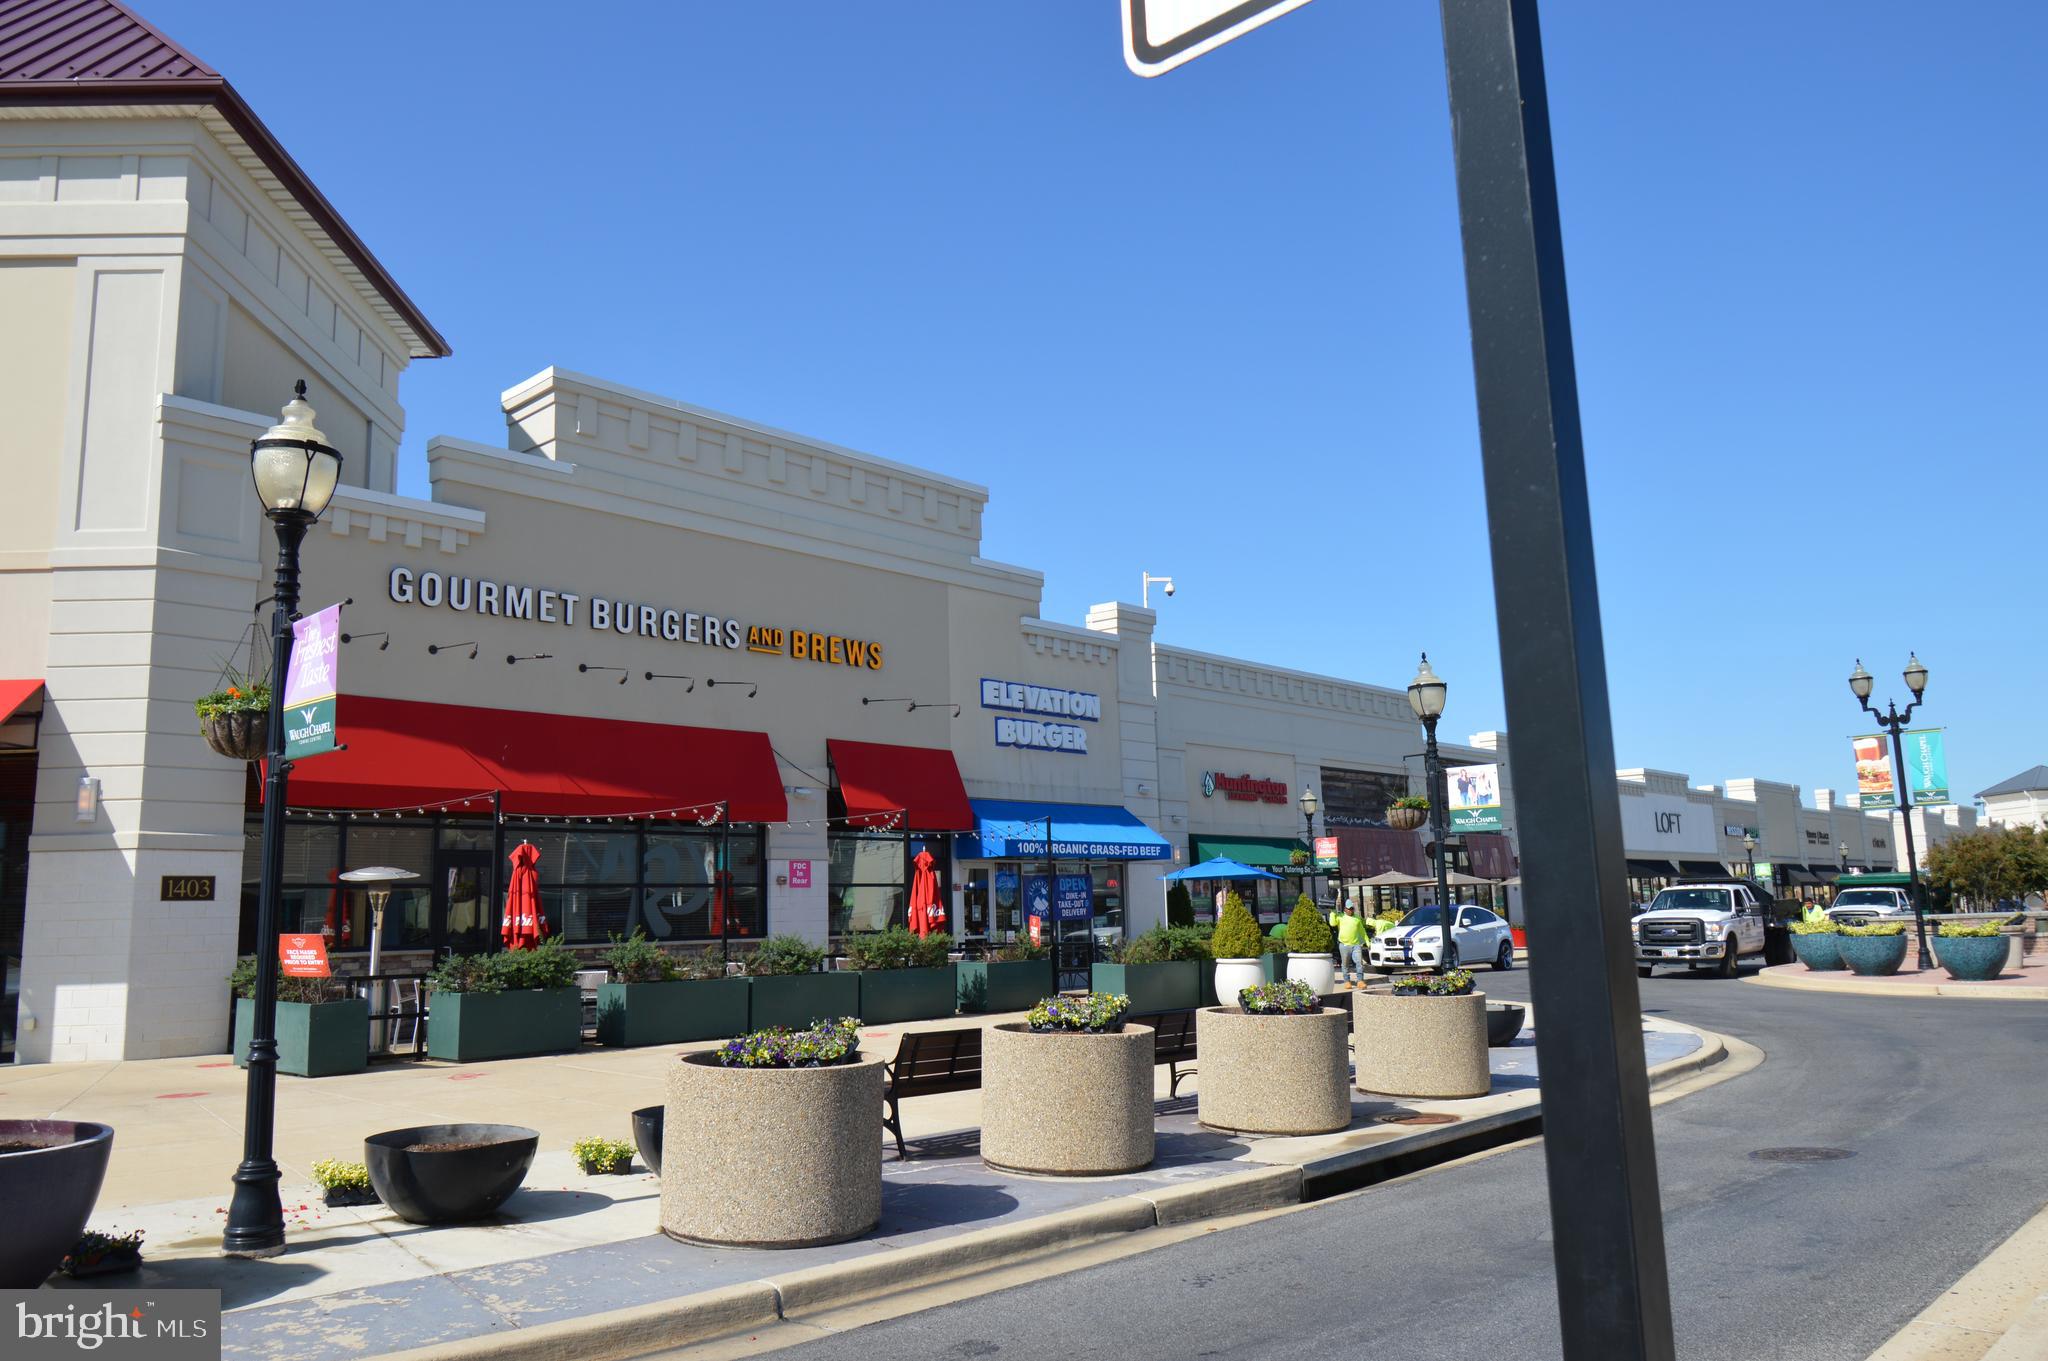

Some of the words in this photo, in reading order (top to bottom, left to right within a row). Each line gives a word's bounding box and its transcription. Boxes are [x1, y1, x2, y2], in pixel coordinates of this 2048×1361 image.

[389, 567, 580, 626] GOURMET
[590, 597, 741, 650] BURGERS
[747, 625, 785, 648] AND
[790, 630, 884, 670] BREWS
[300, 663, 330, 689] Taste
[983, 680, 1100, 720] ELEVATION
[288, 725, 309, 741] WAUGH
[309, 721, 332, 736] CHAPEL
[997, 718, 1087, 751] BURGER
[1214, 772, 1287, 796] Huntington
[1654, 811, 1681, 834] LOFT
[1017, 842, 1044, 854] 100%
[1090, 844, 1139, 856] GRASS-FED
[1140, 846, 1161, 856] BEEF
[793, 862, 807, 870] FDC
[1271, 865, 1283, 873] Your
[167, 879, 211, 897] 1403
[1060, 878, 1086, 891] OPEN
[1058, 900, 1084, 909] TAKE-OUT
[1061, 908, 1087, 917] DELIVERY
